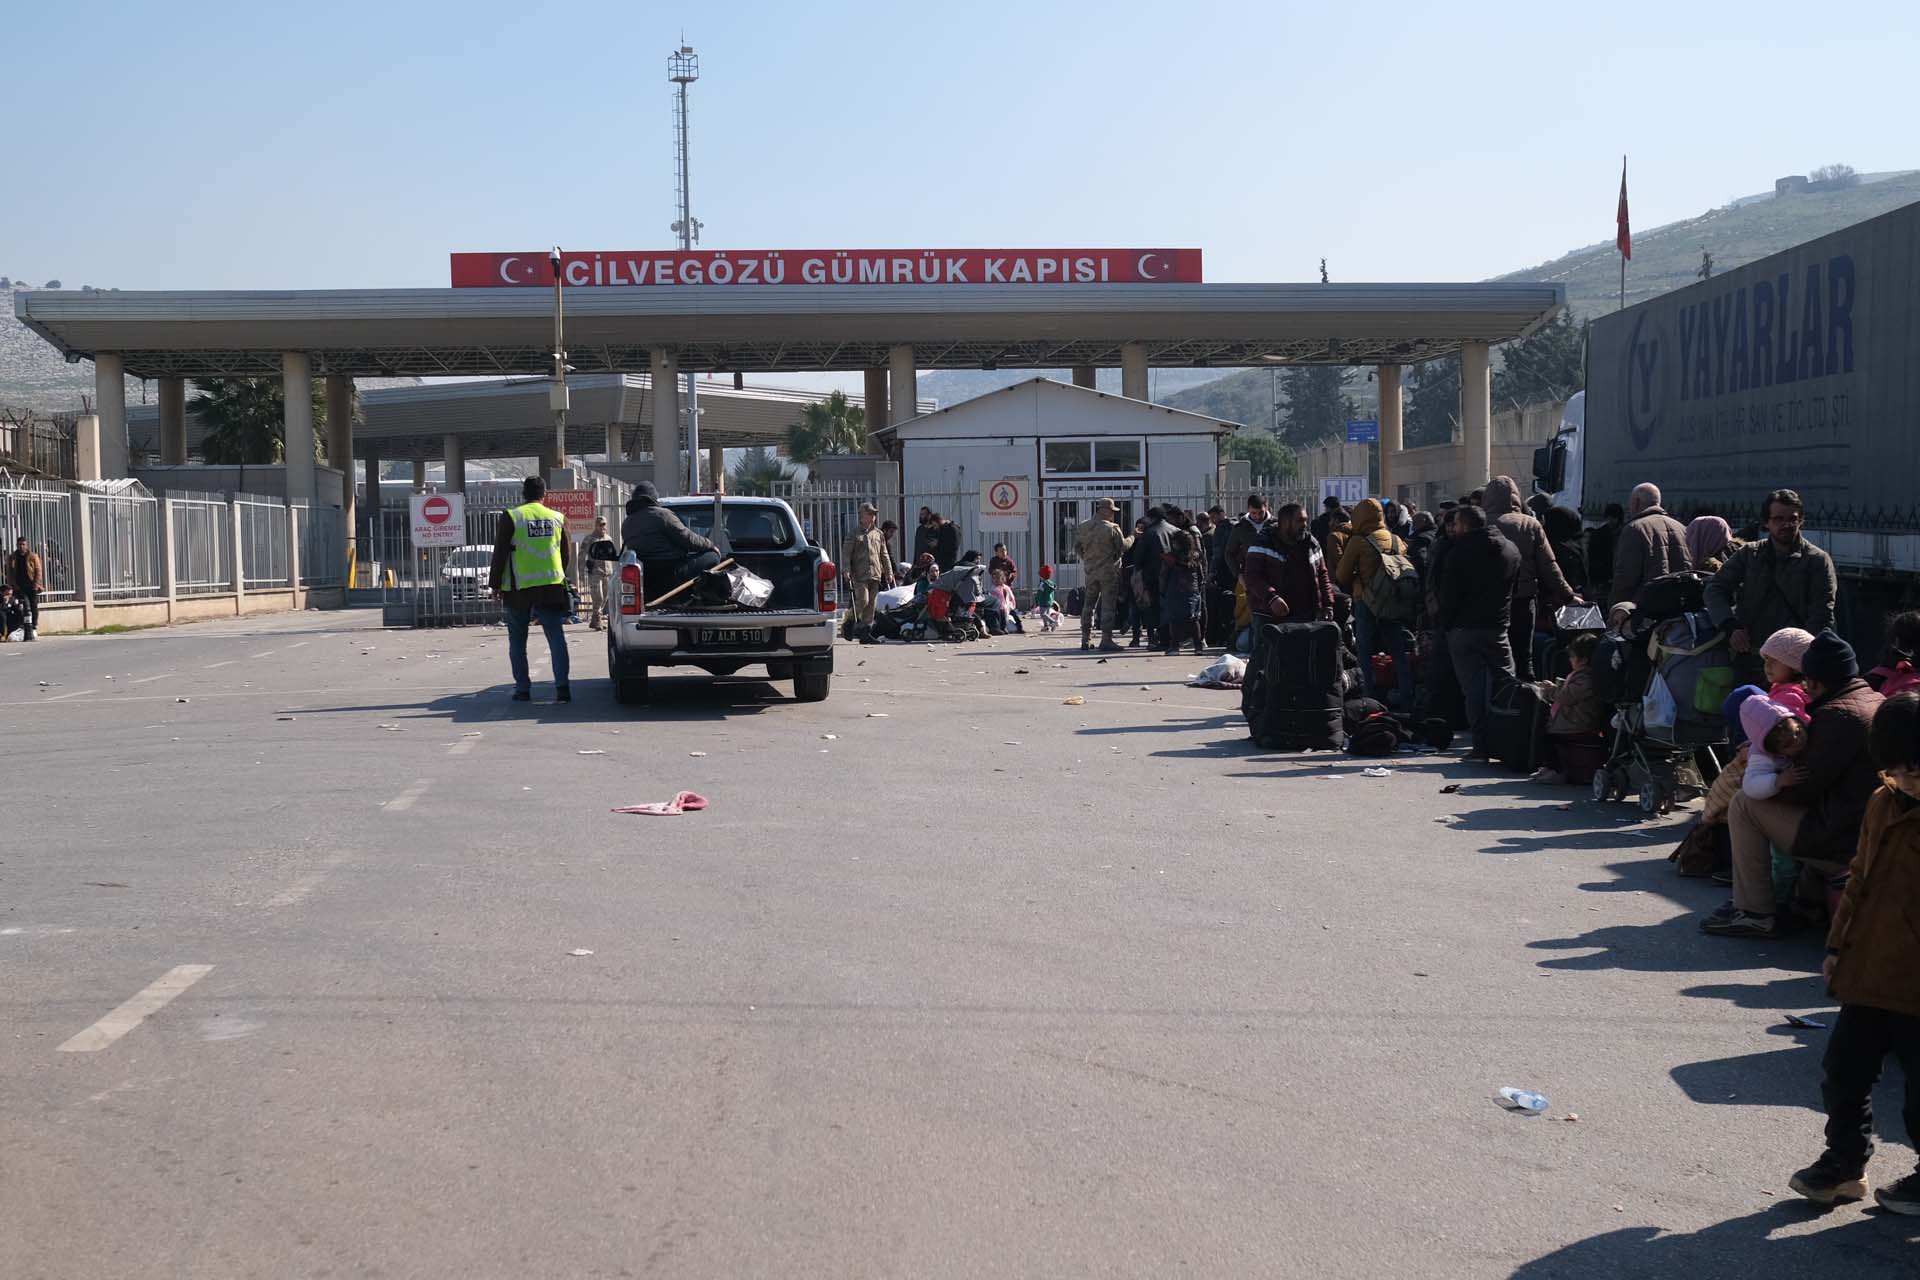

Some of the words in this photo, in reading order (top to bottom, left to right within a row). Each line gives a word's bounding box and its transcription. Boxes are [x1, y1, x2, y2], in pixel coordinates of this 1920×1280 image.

[565, 252, 785, 286] CİLVEGÖZÜ
[802, 251, 968, 283] GÜMRÜK
[984, 257, 1109, 282] KAPISI
[1678, 254, 1855, 401] YAYARLAR
[547, 492, 589, 502] PROTOKOL
[1326, 480, 1361, 500] TIR
[701, 629, 713, 641] 07
[743, 629, 761, 641] 510
